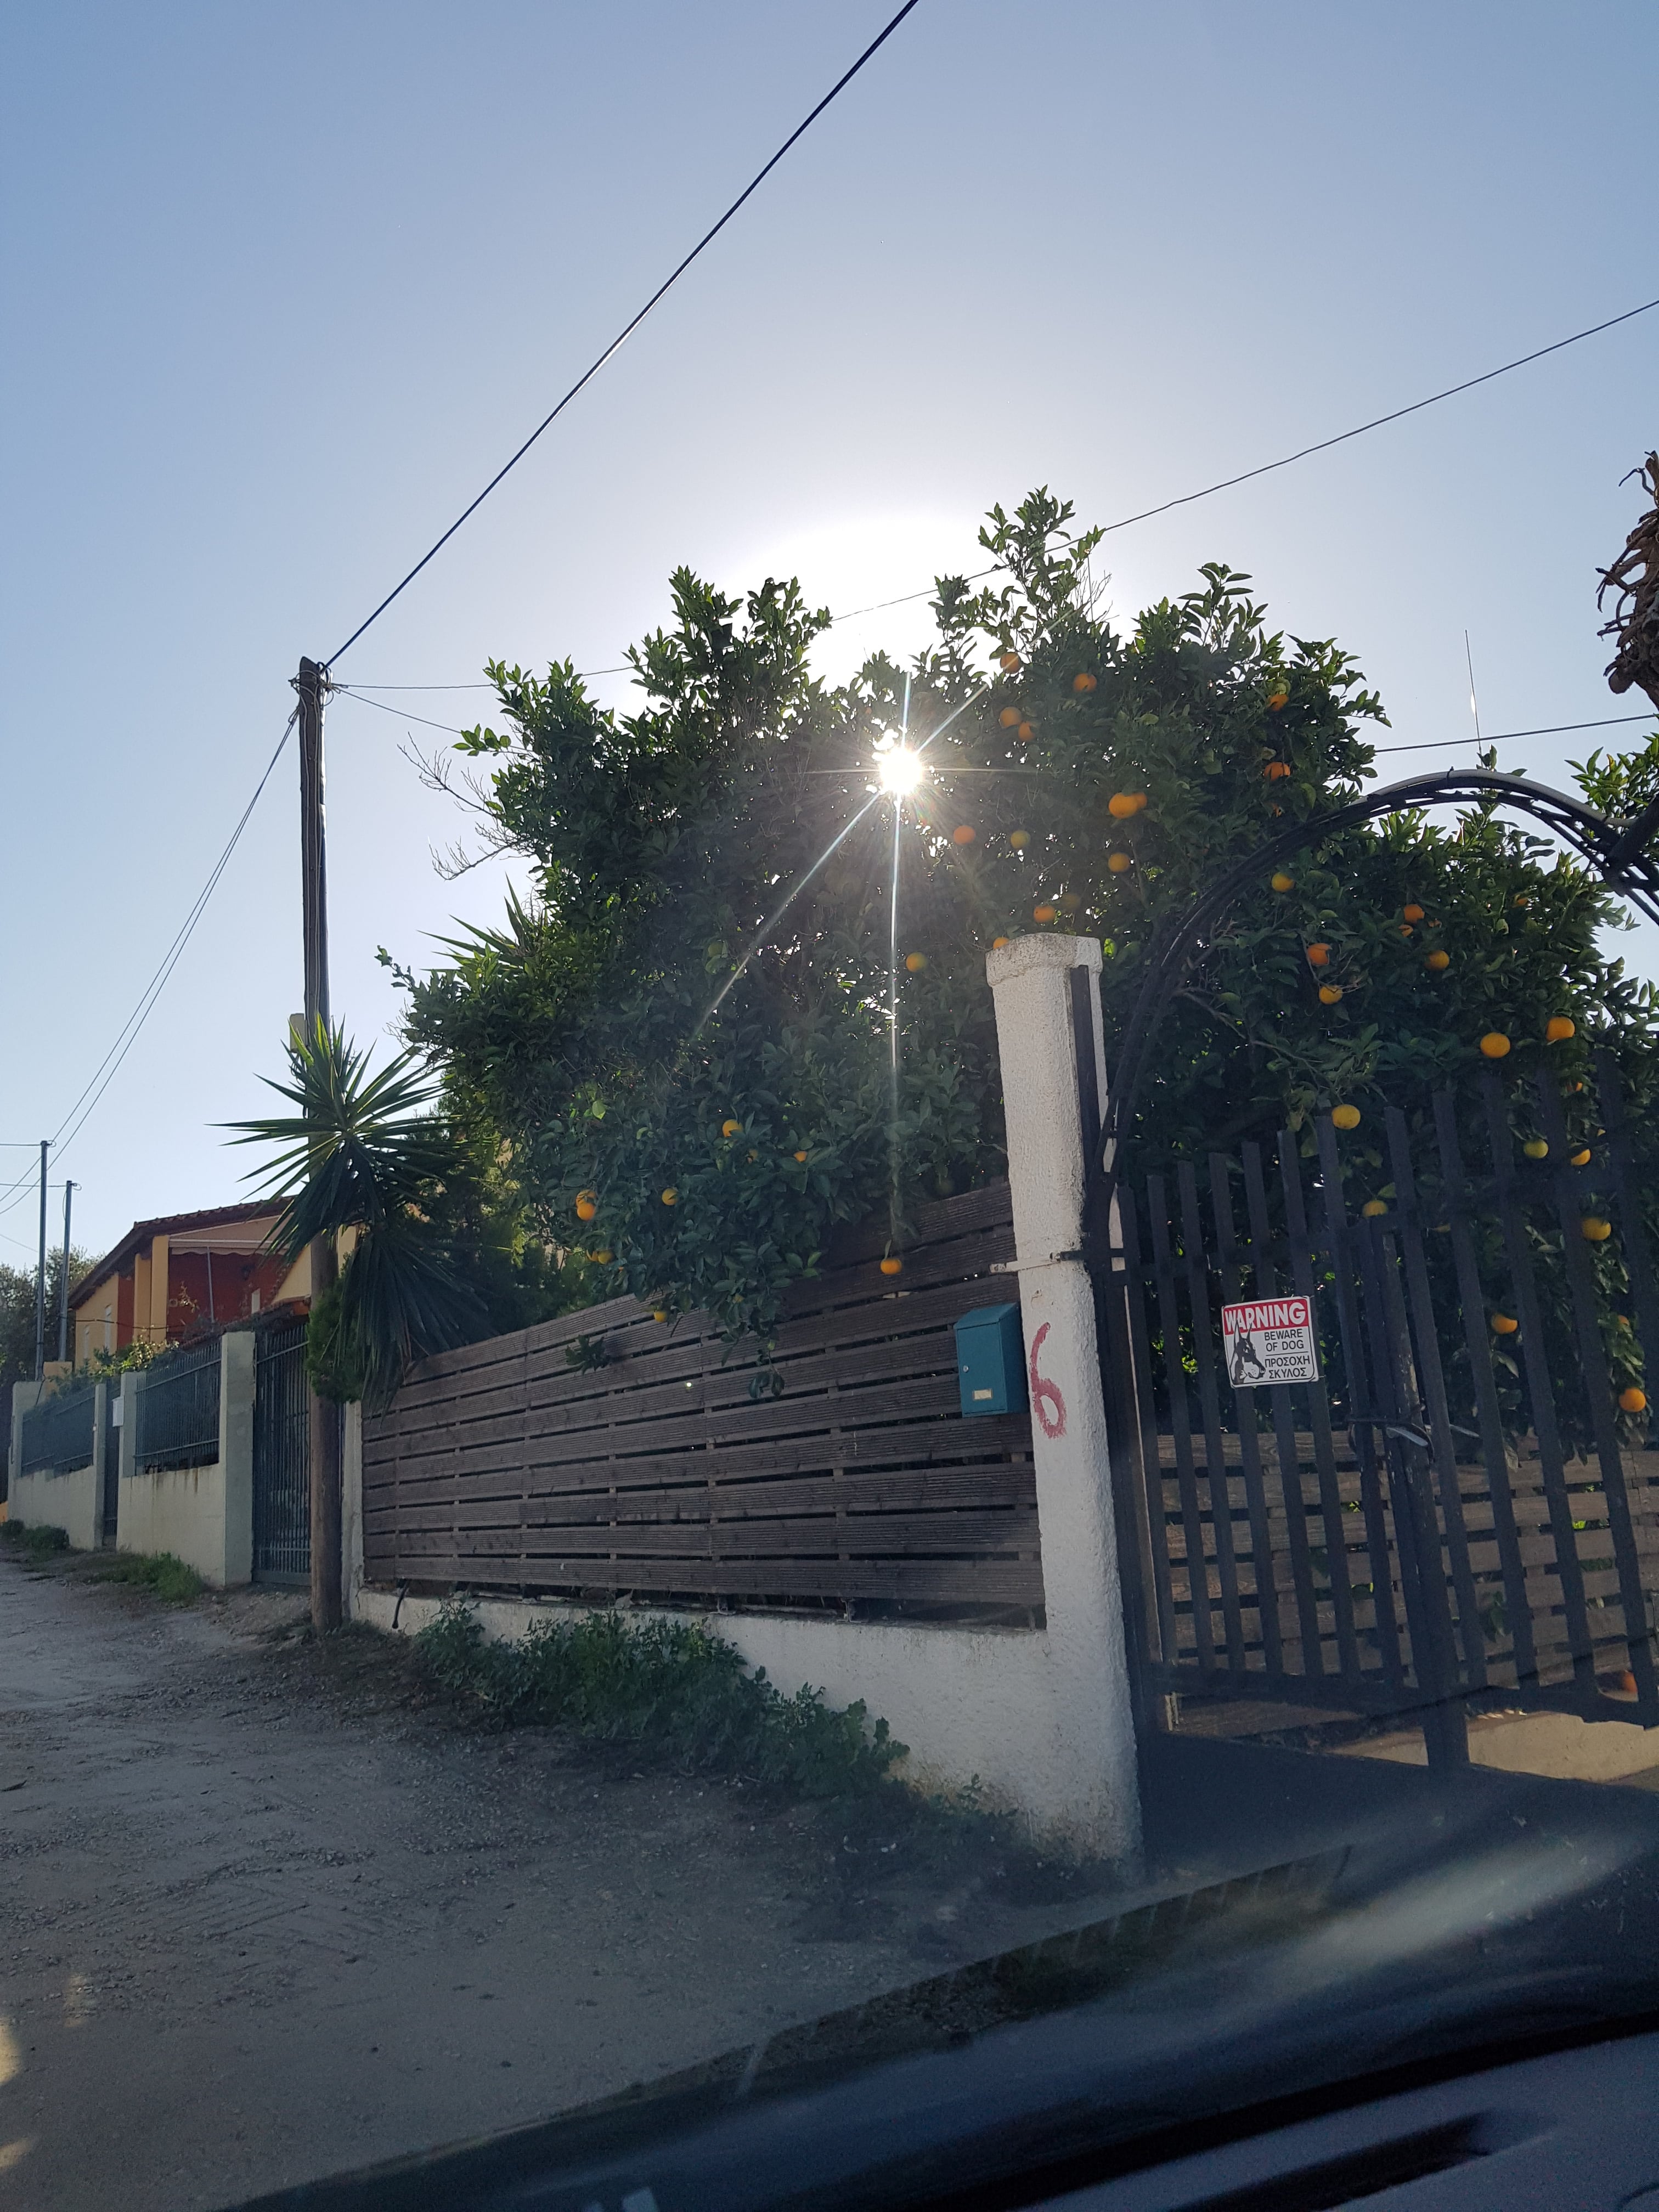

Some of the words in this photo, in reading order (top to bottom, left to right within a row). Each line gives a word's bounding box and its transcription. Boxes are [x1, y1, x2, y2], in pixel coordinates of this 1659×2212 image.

[1224, 1302, 1306, 1332] WARNING
[1265, 1329, 1304, 1341] BEWARE
[1266, 1342, 1278, 1352] OF
[1282, 1340, 1304, 1350] DOG
[1265, 1356, 1310, 1368] ΠΡΟΣΟΧΗ
[1269, 1368, 1307, 1379] ΣΚΥΛΟΣ
[1030, 1322, 1066, 1438] 6
